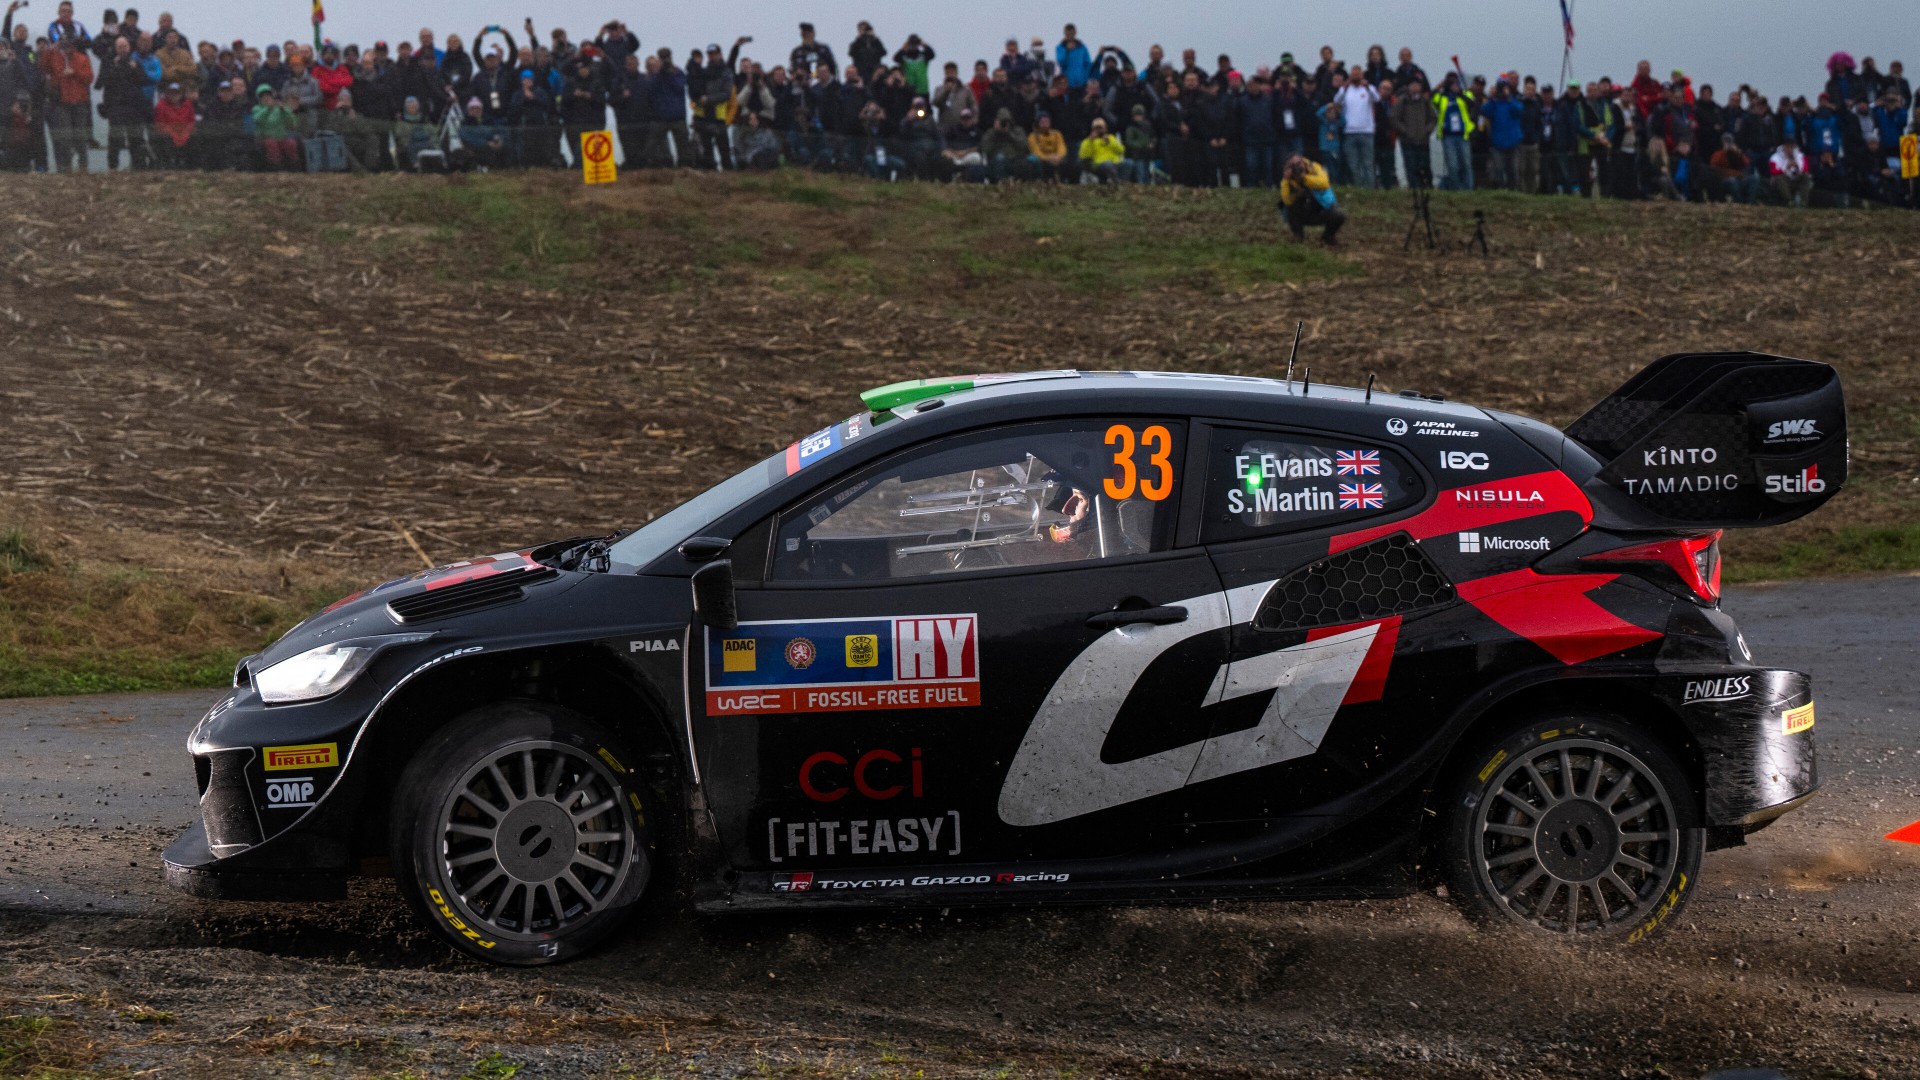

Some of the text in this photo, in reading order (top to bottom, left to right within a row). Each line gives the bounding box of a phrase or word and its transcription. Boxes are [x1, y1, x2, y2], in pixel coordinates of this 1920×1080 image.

[1416, 428, 1480, 437] AIRLINES
[1767, 418, 1816, 438] SWS
[1103, 424, 1173, 501] 33
[1624, 474, 1739, 495] TAMADIC
[1765, 464, 1826, 493] Stilo
[1456, 490, 1545, 502] NISULA
[1483, 536, 1551, 551] Microsoft
[629, 639, 681, 653] PIAA
[724, 640, 755, 652] ADAC
[899, 618, 972, 679] HY
[1683, 675, 1751, 700] ENDLESS
[717, 694, 780, 710] WRC
[808, 687, 968, 708] FOSSIL-FREE FUEL
[269, 748, 330, 767] PIRELLI
[266, 782, 315, 803] OMP
[911, 875, 991, 886] GAZOO
[996, 871, 1070, 884] Racing
